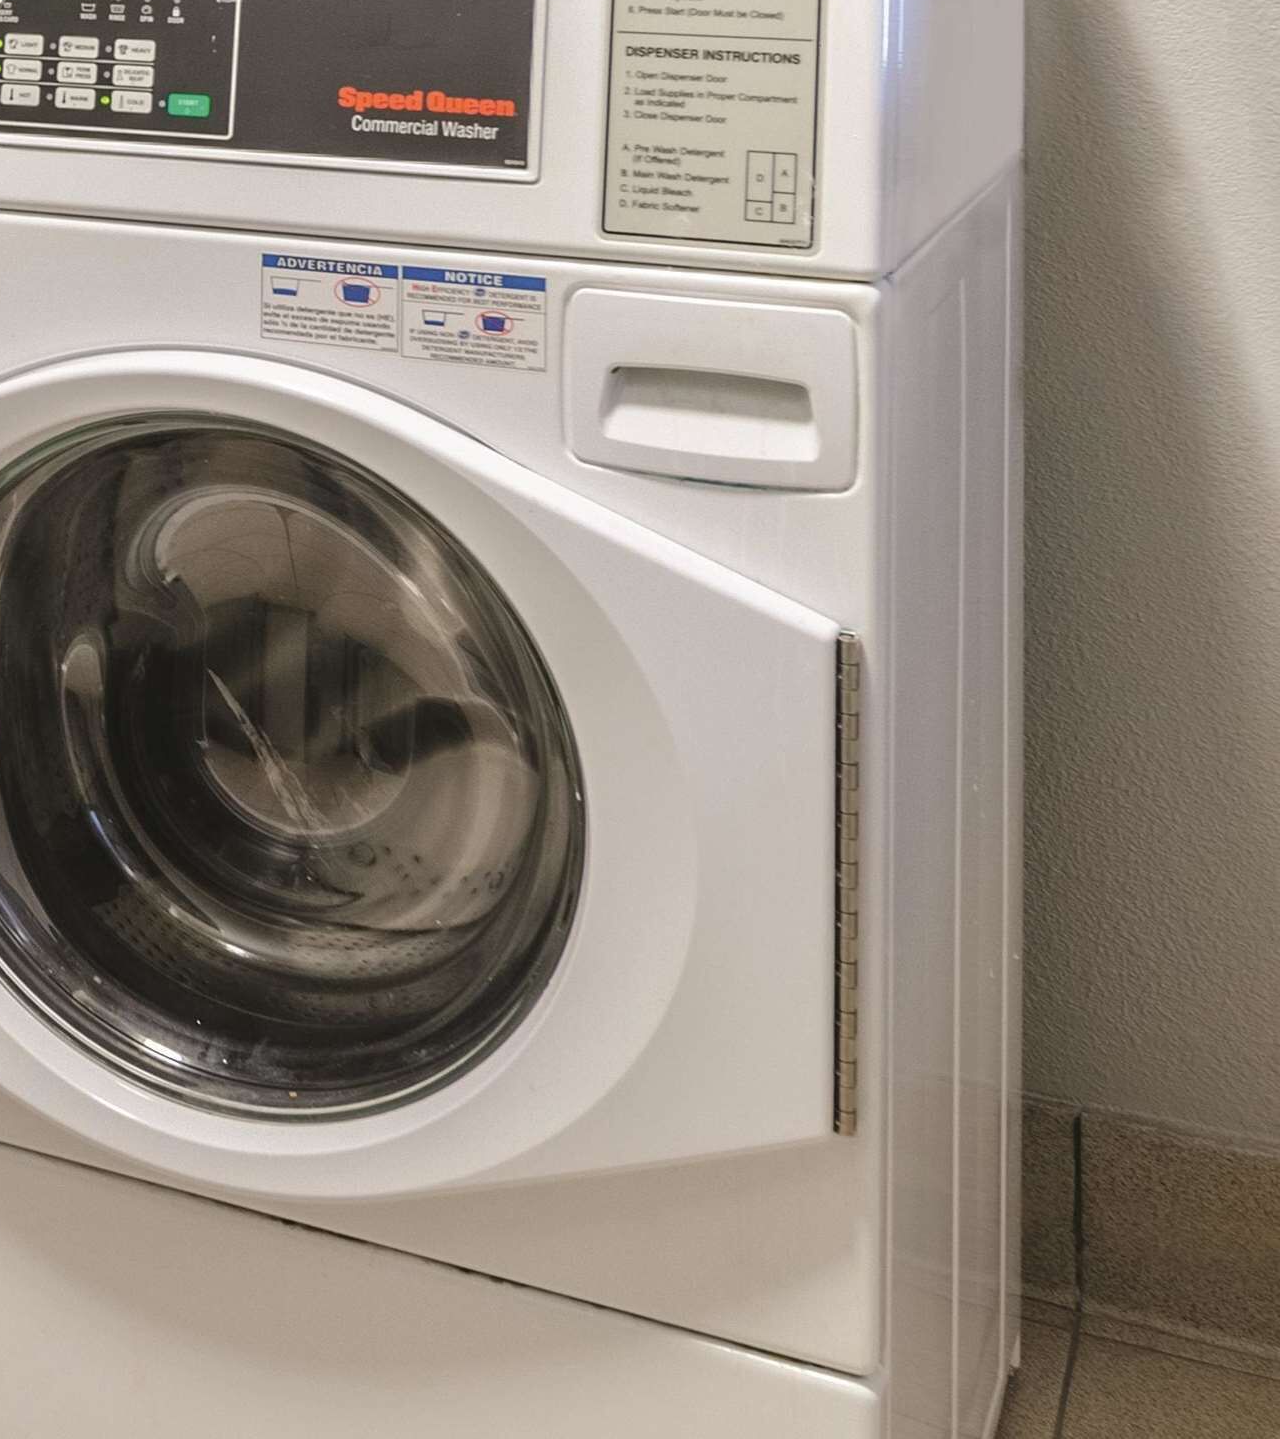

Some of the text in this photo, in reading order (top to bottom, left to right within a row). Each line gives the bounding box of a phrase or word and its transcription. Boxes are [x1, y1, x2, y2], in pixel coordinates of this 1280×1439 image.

[626, 46, 801, 64] DISPENSER INSTRUCTIONS
[338, 86, 515, 116] Speed Queen
[352, 114, 499, 140] Commercial Washer
[277, 257, 383, 275] ADVERTENCIA
[444, 271, 503, 286] NOTICE
